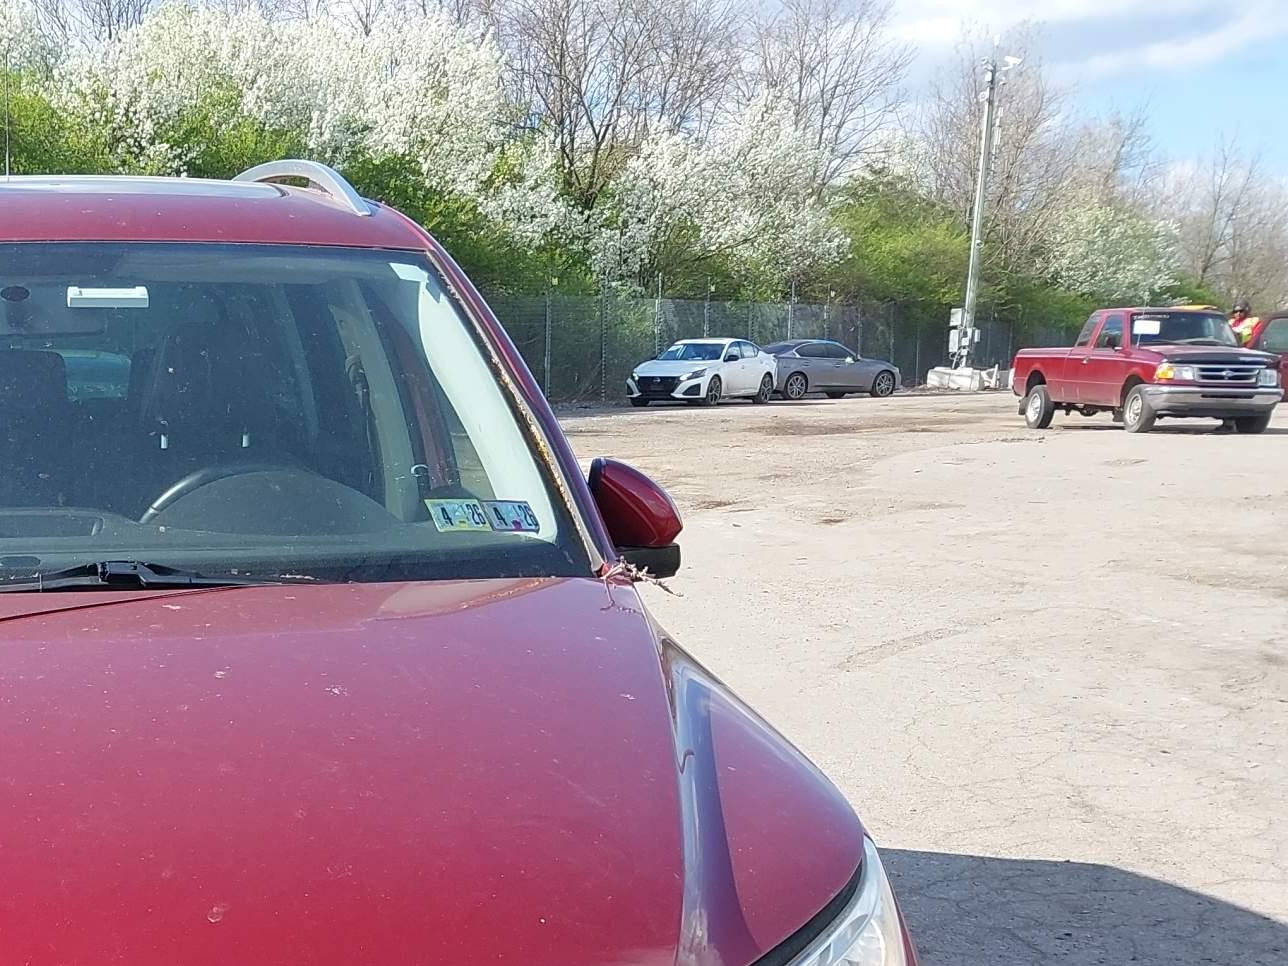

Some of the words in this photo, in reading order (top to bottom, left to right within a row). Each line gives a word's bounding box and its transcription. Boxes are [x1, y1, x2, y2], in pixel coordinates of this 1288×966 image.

[440, 507, 454, 526] 4
[467, 504, 487, 525] 26
[492, 507, 508, 526] 4
